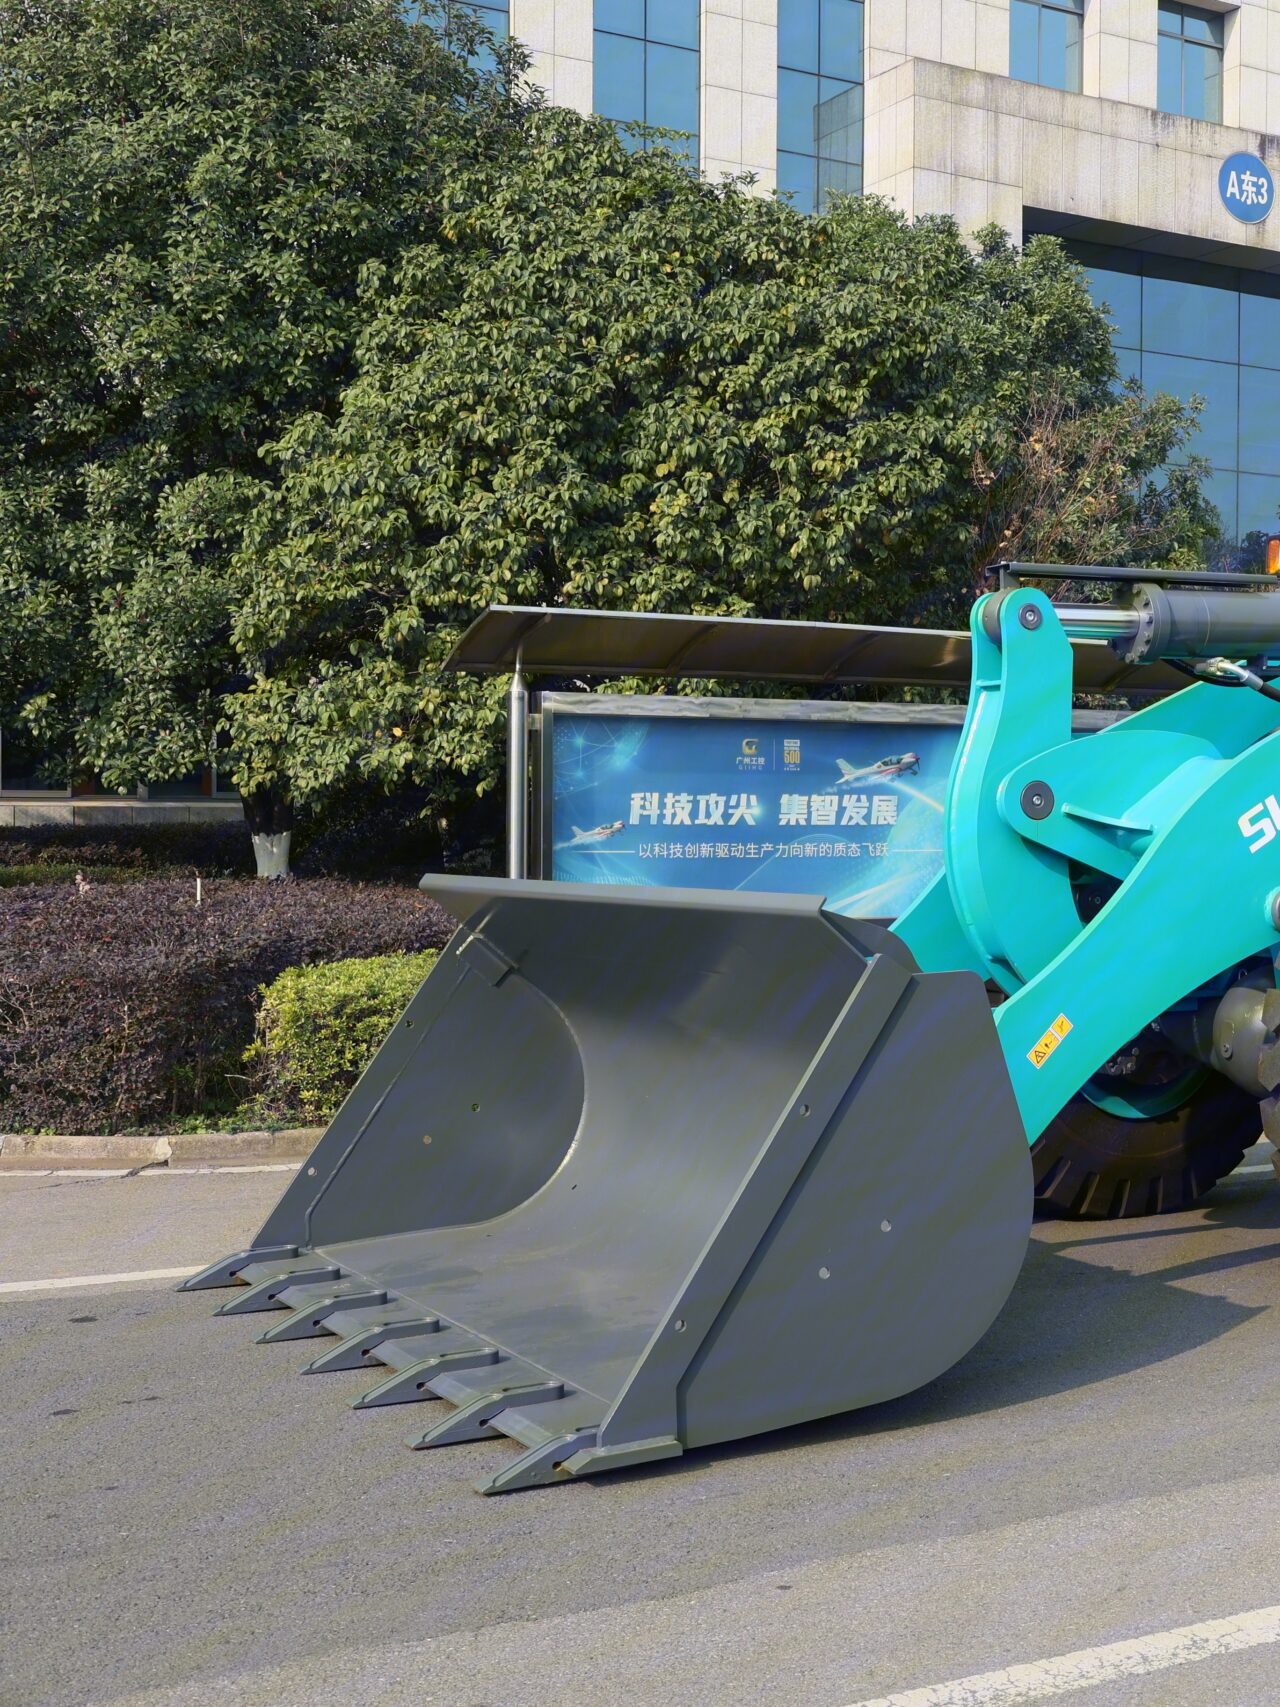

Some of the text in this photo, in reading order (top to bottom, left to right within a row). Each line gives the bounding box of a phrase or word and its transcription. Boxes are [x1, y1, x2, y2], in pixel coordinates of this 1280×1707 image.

[1226, 170, 1268, 205] A东3
[629, 792, 899, 826] 科技攻尖 集智发展
[638, 842, 889, 859] 以科技创新驱动生产力向新的质态飞跃
